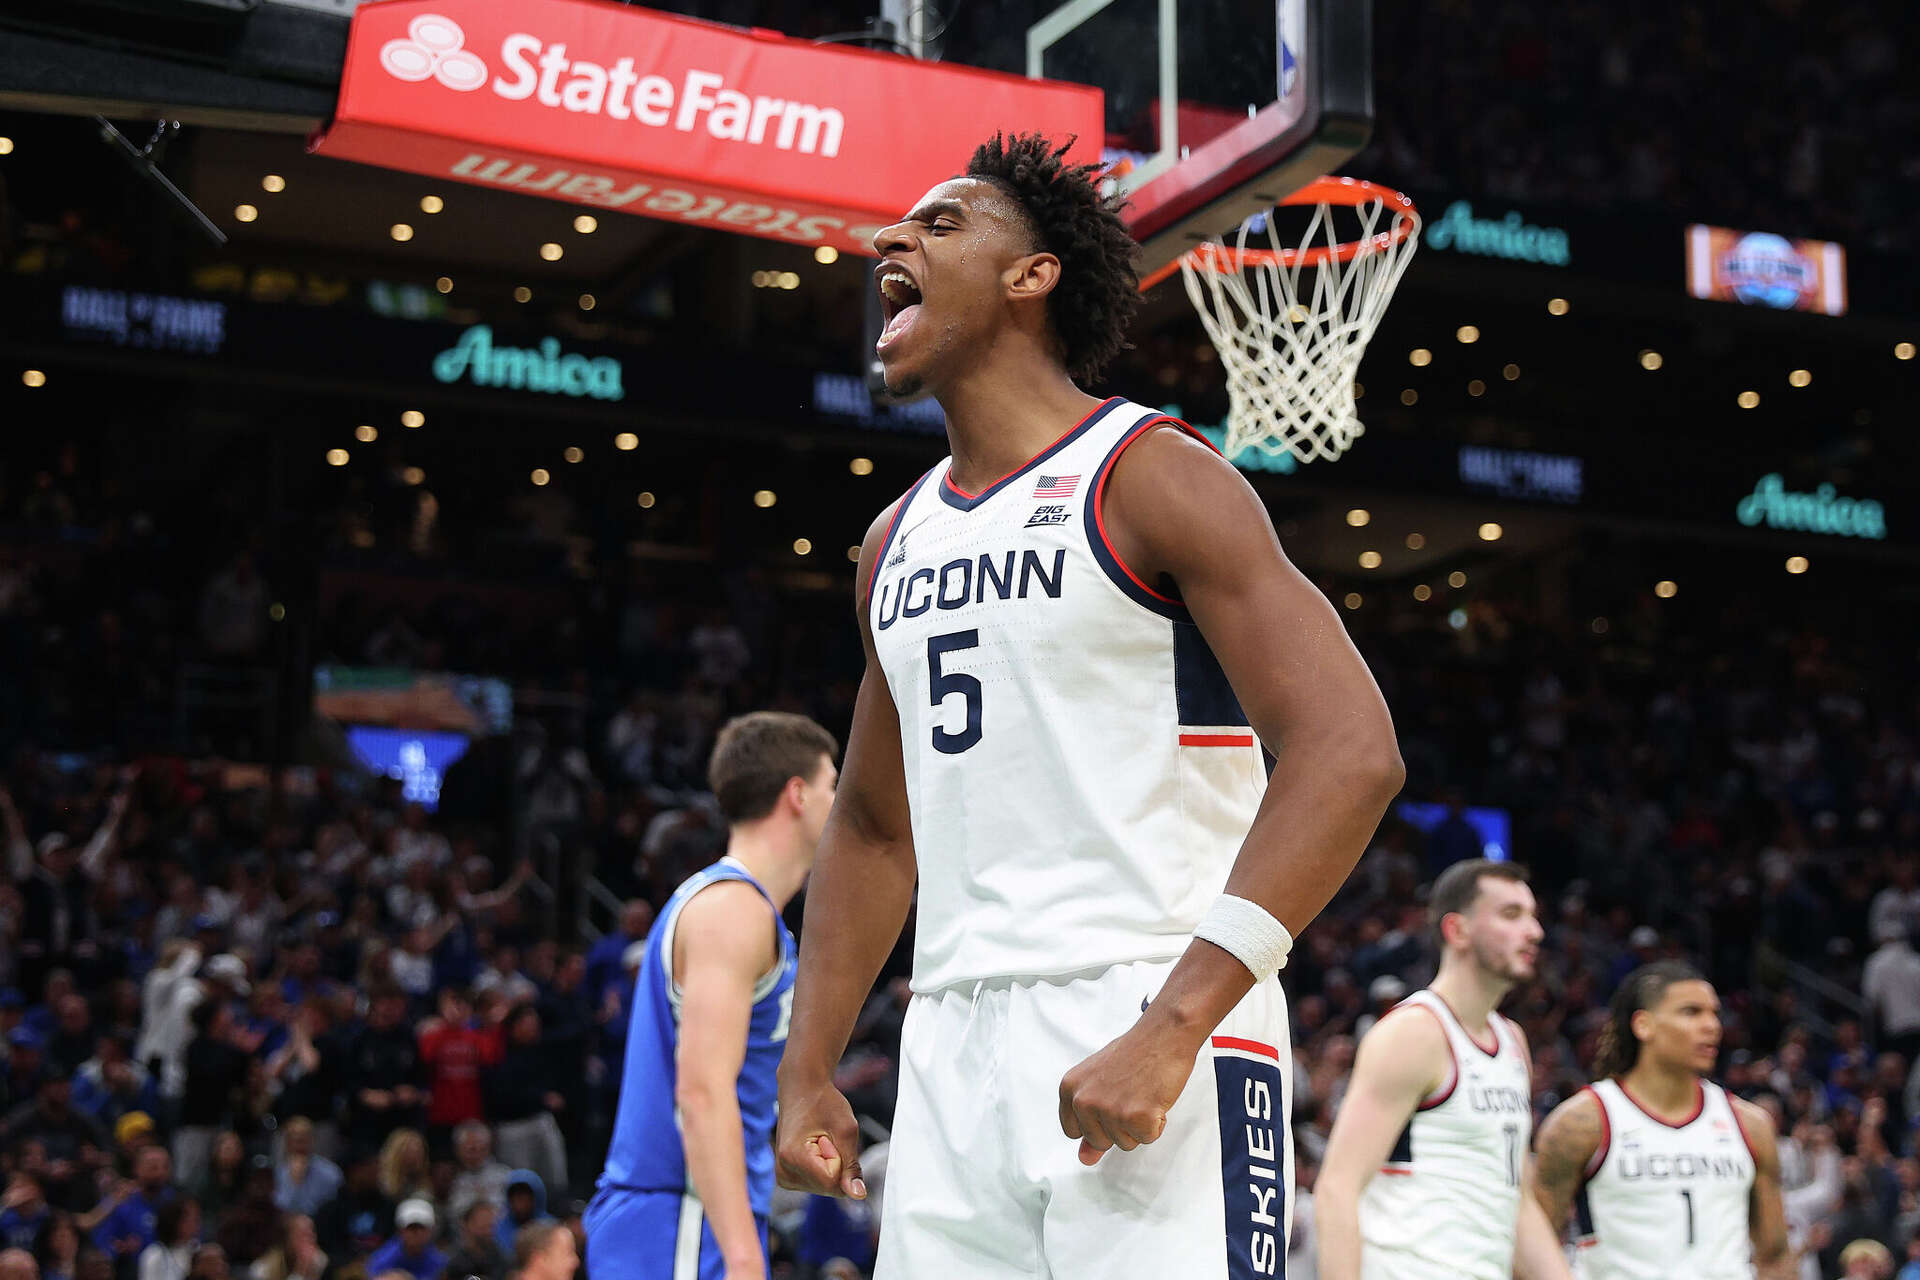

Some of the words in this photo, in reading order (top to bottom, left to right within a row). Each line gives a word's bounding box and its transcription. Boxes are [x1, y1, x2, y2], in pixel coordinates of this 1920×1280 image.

[1426, 201, 1569, 265] Amica
[434, 325, 624, 401] Amica
[1028, 514, 1072, 523] EAST
[1034, 505, 1066, 514] BIG
[1736, 474, 1885, 539] Amica
[878, 549, 1066, 631] UCONN
[927, 628, 983, 755] 5
[1245, 1077, 1279, 1280] SKIES
[1619, 1154, 1746, 1181] UCONN
[1681, 1189, 1694, 1246] 1
